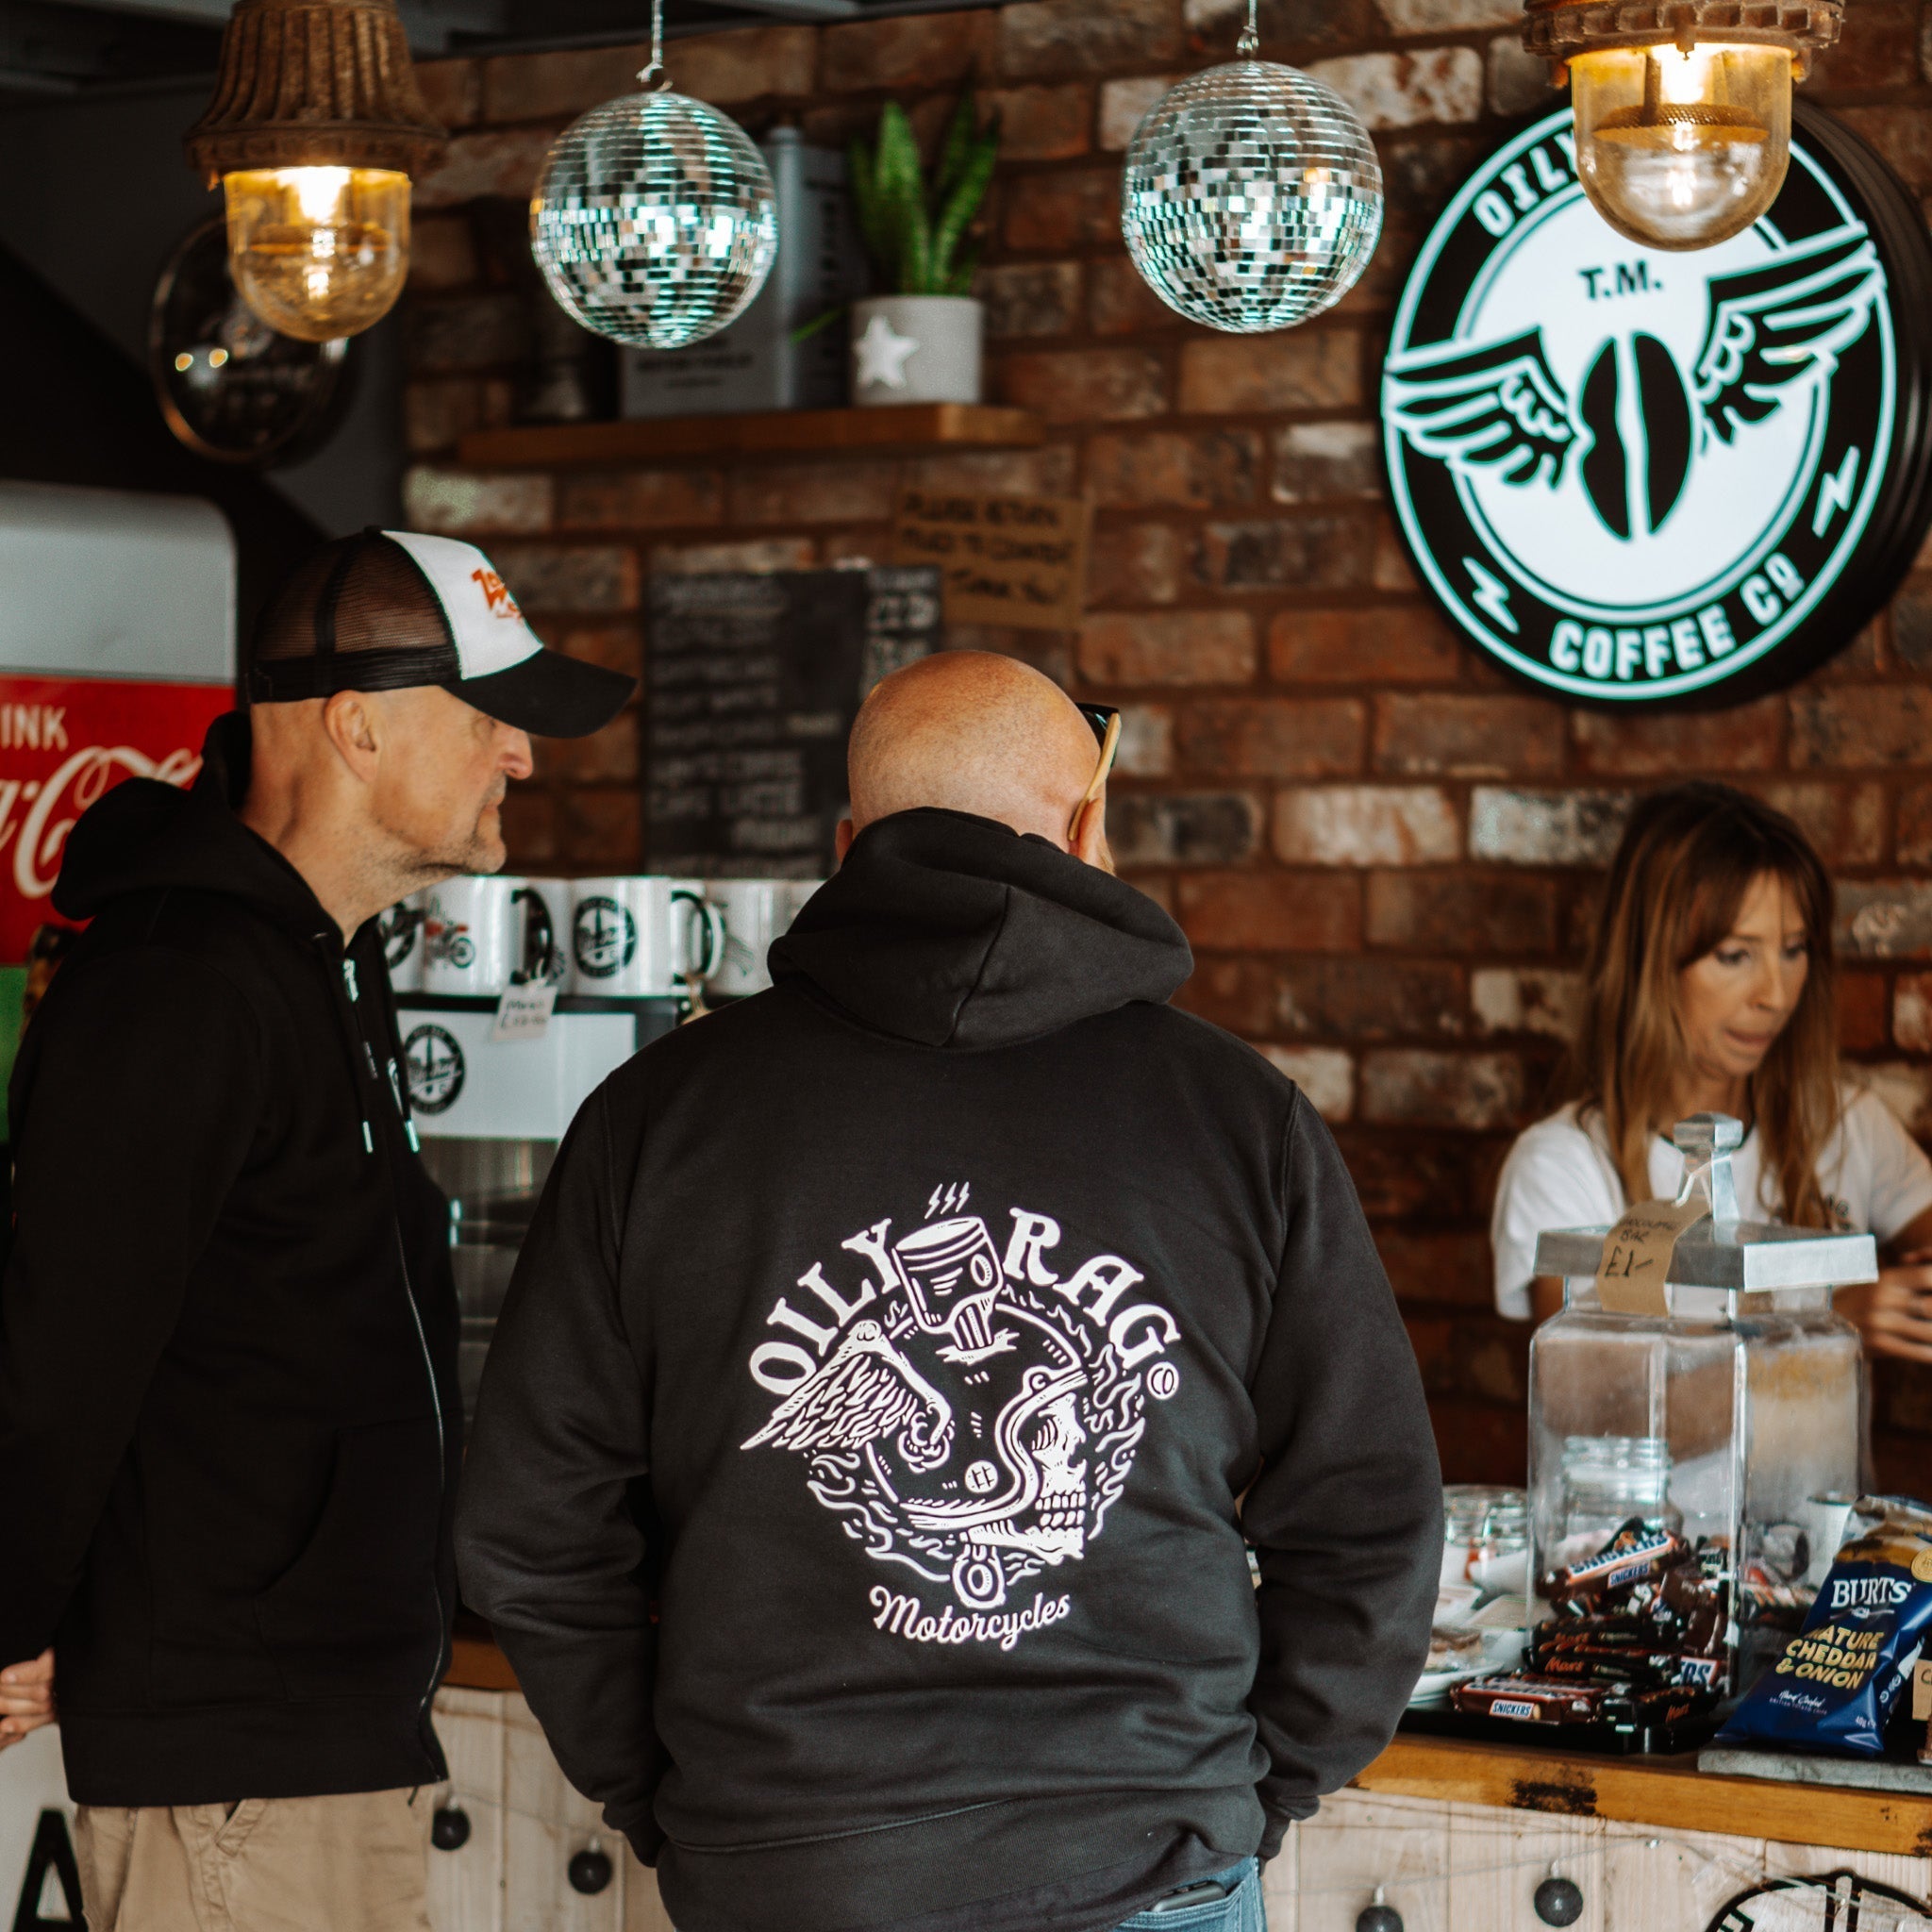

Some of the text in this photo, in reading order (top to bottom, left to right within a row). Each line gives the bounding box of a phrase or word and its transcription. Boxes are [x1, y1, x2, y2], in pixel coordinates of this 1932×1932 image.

[1578, 259, 1663, 301] T.M.
[1548, 603, 1737, 681] COFFEE
[0, 705, 69, 752] INK
[750, 1208, 1181, 1395] OILY RAG
[1610, 1562, 1649, 1586] SNICKERS
[1830, 1576, 1912, 1608] BURTS
[869, 1585, 1071, 1651] Motorcycles
[1544, 1656, 1585, 1673] Mars
[1786, 1639, 1878, 1671] CHEDDAR
[1775, 1657, 1865, 1690] & ONION
[1492, 1702, 1531, 1717] SNICKERS
